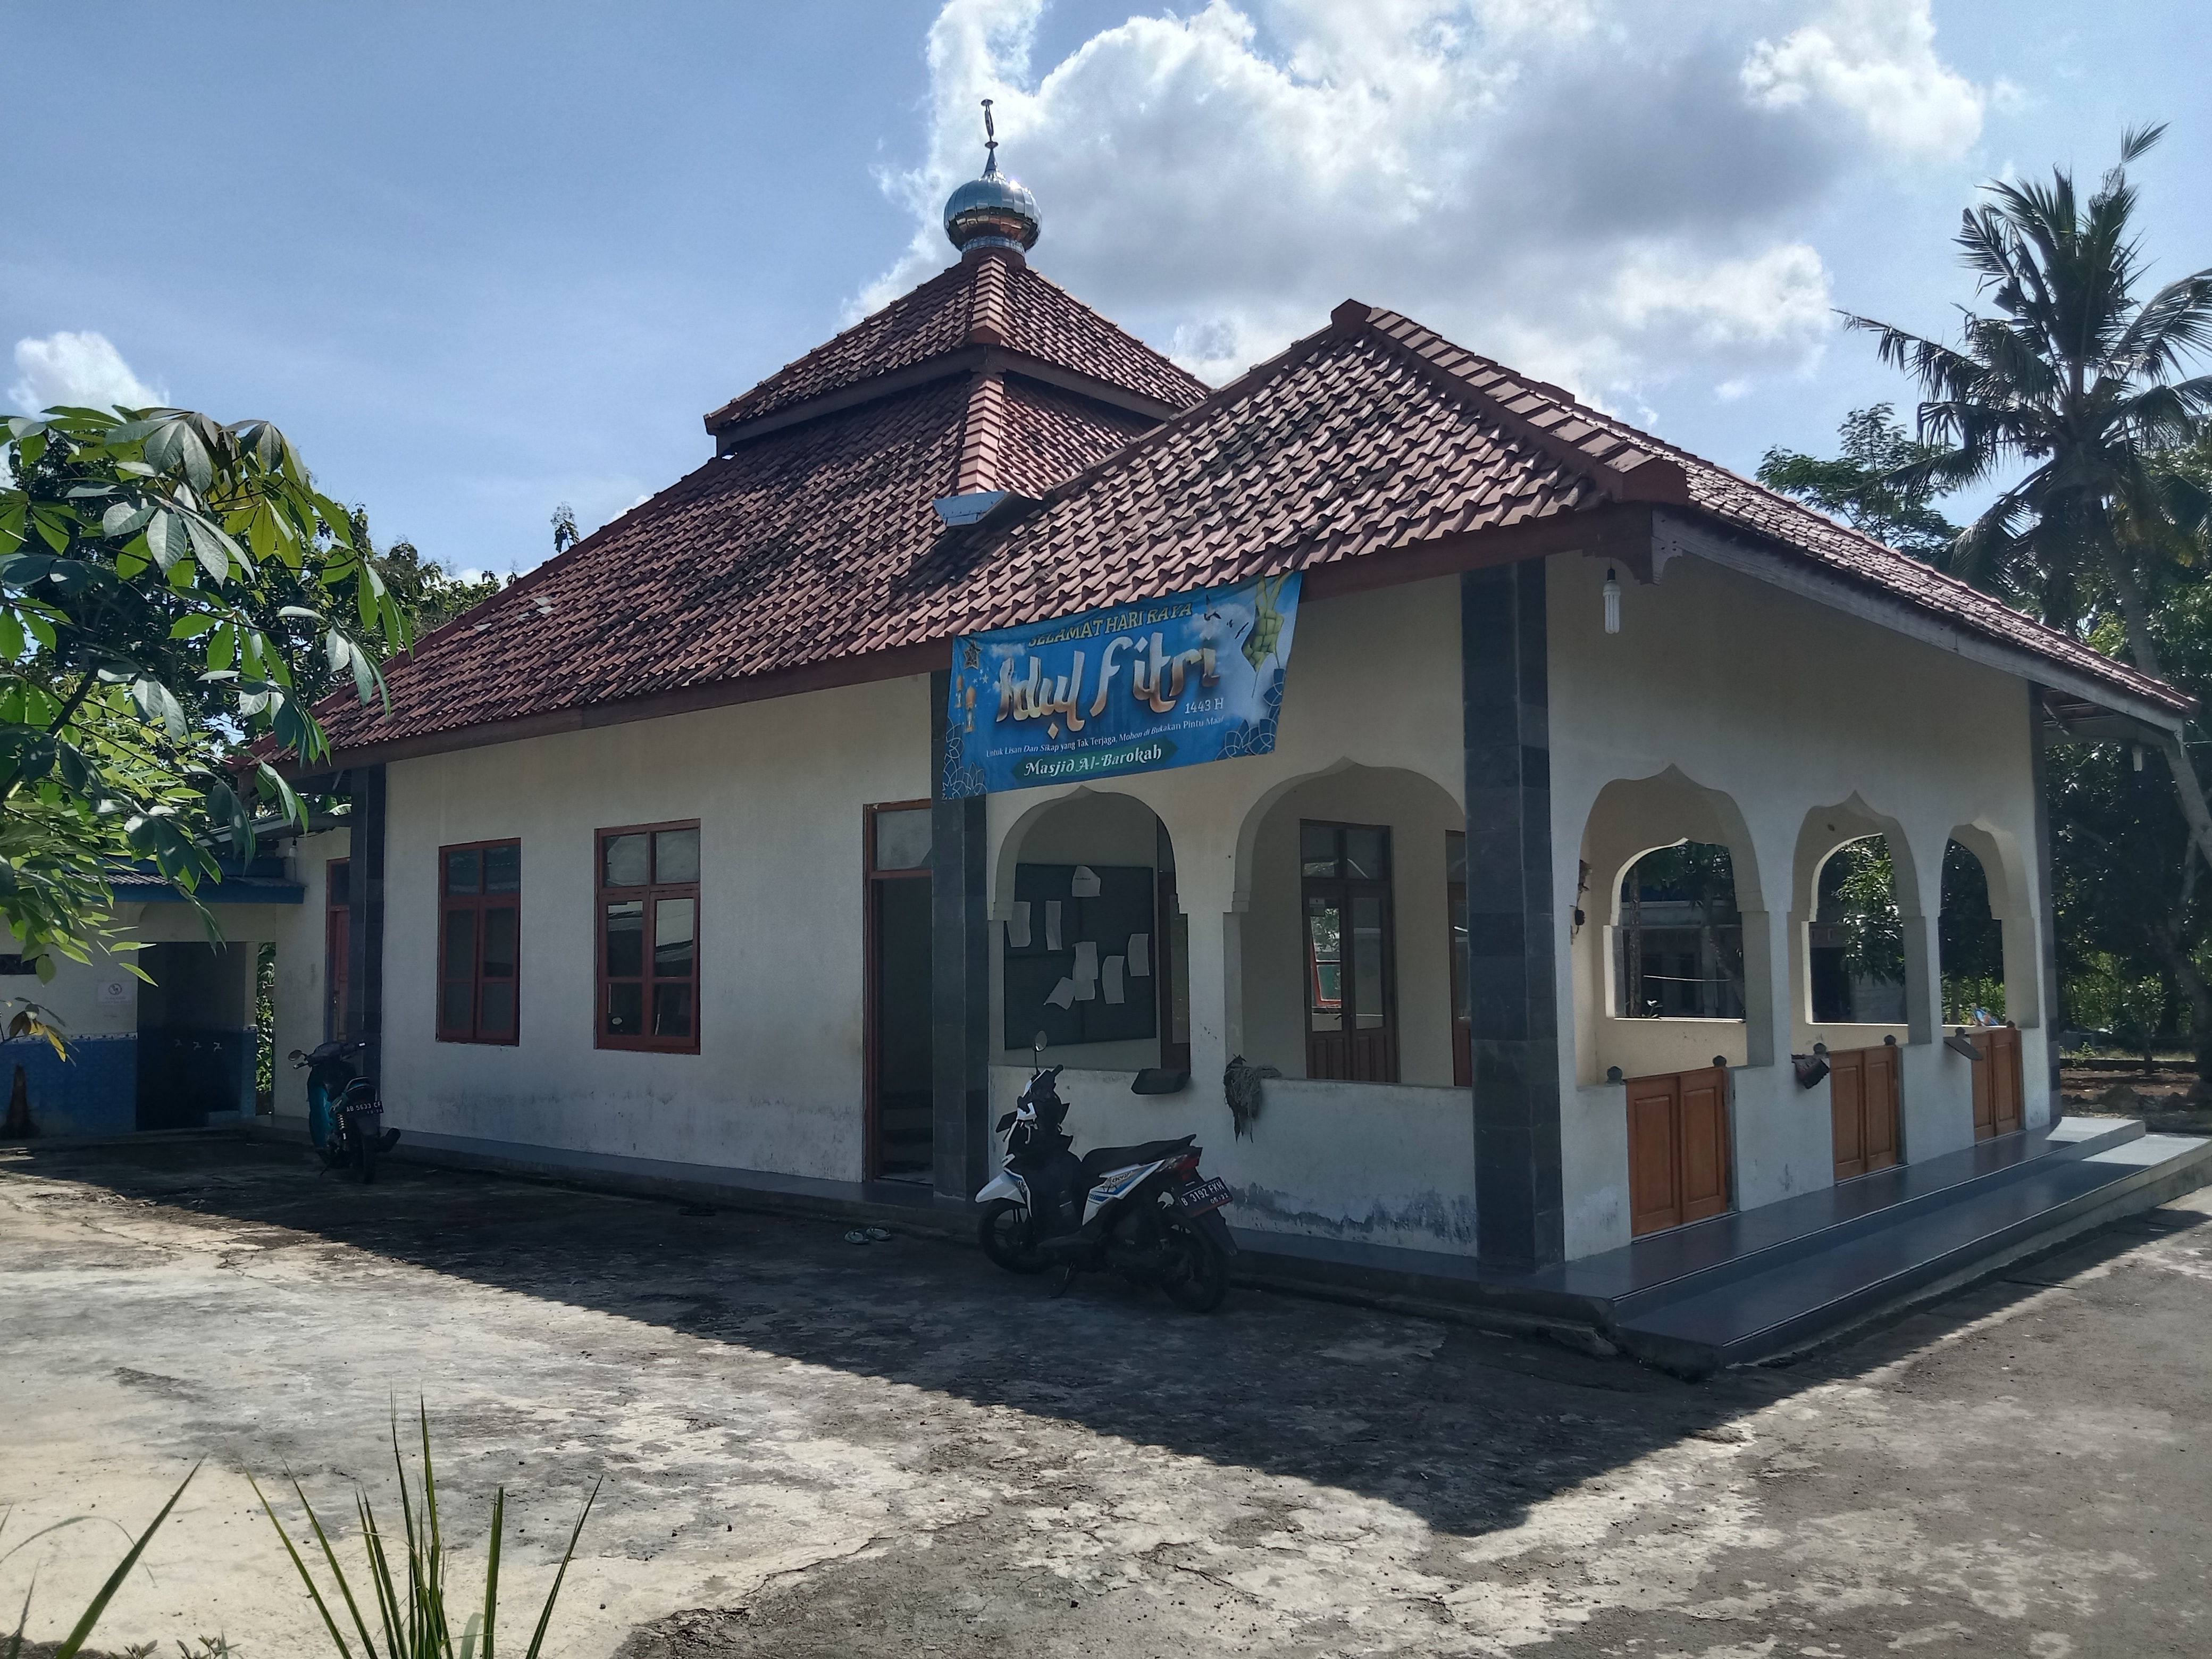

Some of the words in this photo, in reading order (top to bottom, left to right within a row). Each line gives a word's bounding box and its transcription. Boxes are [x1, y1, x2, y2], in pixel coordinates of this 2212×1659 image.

[1028, 619, 1103, 647] SELAMAT
[1104, 611, 1143, 634] HARI
[1146, 602, 1192, 624] RAYA
[1184, 699, 1210, 715] 1443
[1214, 698, 1224, 710] H
[986, 749, 1003, 758] Untuk
[1004, 747, 1022, 755] Lisan
[1060, 742, 1075, 750] yang
[1090, 736, 1117, 747] Terjaga,
[1119, 731, 1143, 742] Mohon
[1143, 728, 1150, 736] di
[1151, 723, 1181, 734] Bukakan
[1183, 719, 1204, 730] Pintu
[1205, 715, 1225, 725] Maaf
[1024, 759, 1075, 777] Masjid
[1076, 744, 1162, 772] Al-Barokah
[1180, 1197, 1188, 1206] B
[1189, 1188, 1210, 1202] 3192
